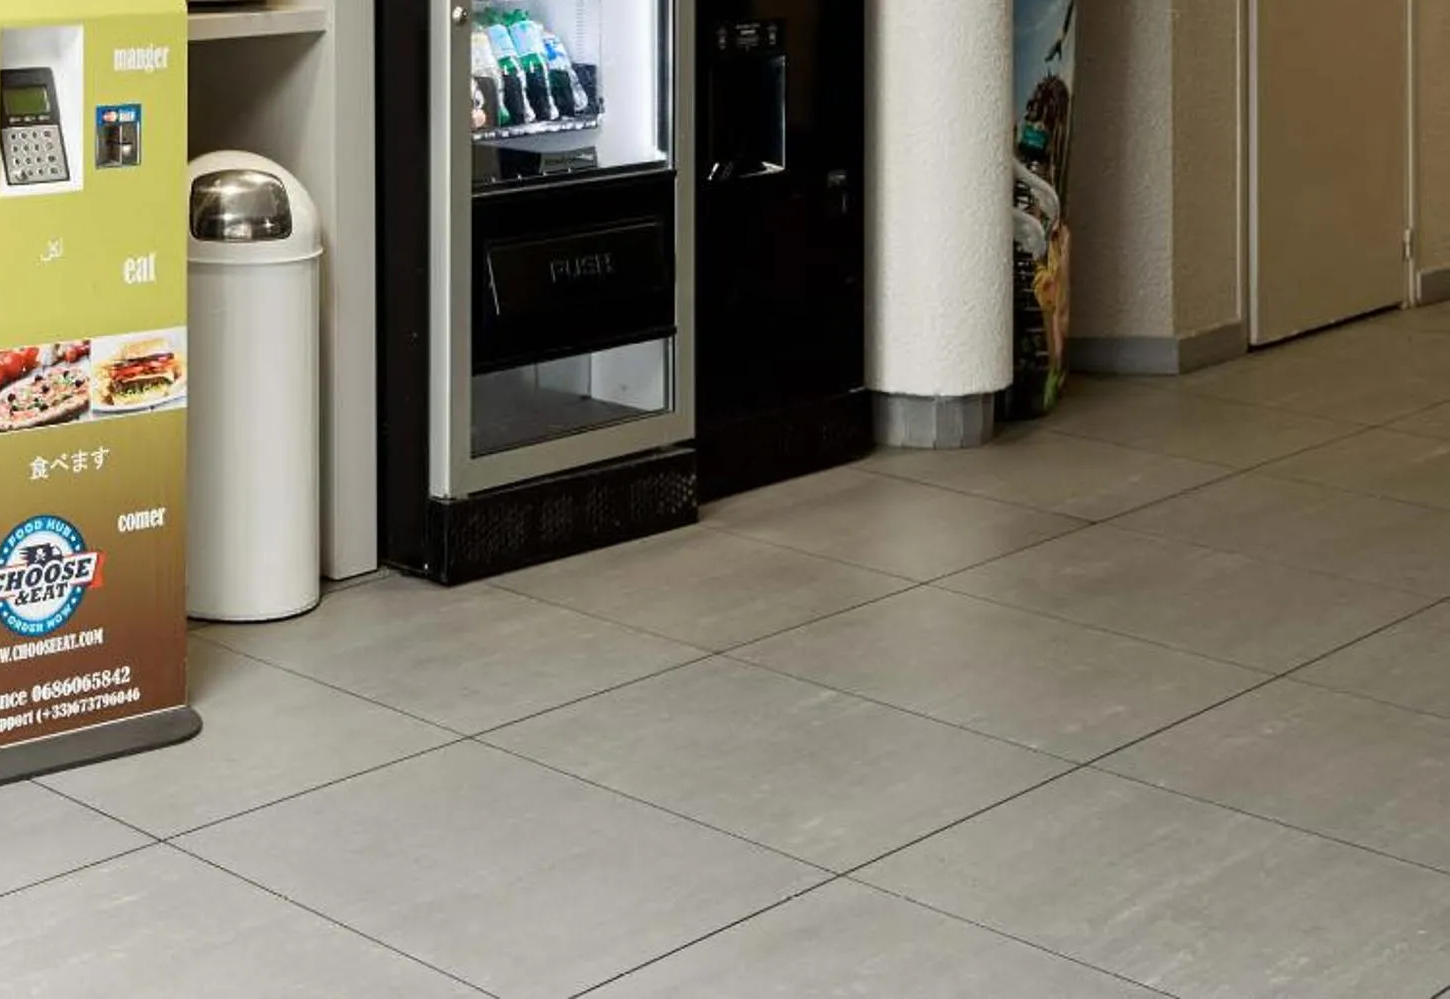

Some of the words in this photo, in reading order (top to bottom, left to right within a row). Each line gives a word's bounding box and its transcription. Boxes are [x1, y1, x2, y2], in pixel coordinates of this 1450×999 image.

[113, 44, 170, 73] manger
[123, 253, 156, 284] eat
[548, 252, 615, 284] PUSH
[29, 446, 110, 480] 食べます
[8, 520, 43, 547] FOOD
[46, 519, 73, 538] HUB
[117, 506, 166, 532] comer
[15, 582, 69, 606] &EAT
[7, 615, 44, 632] ORDER
[47, 604, 72, 629] NOW
[32, 666, 131, 703] 0686065842
